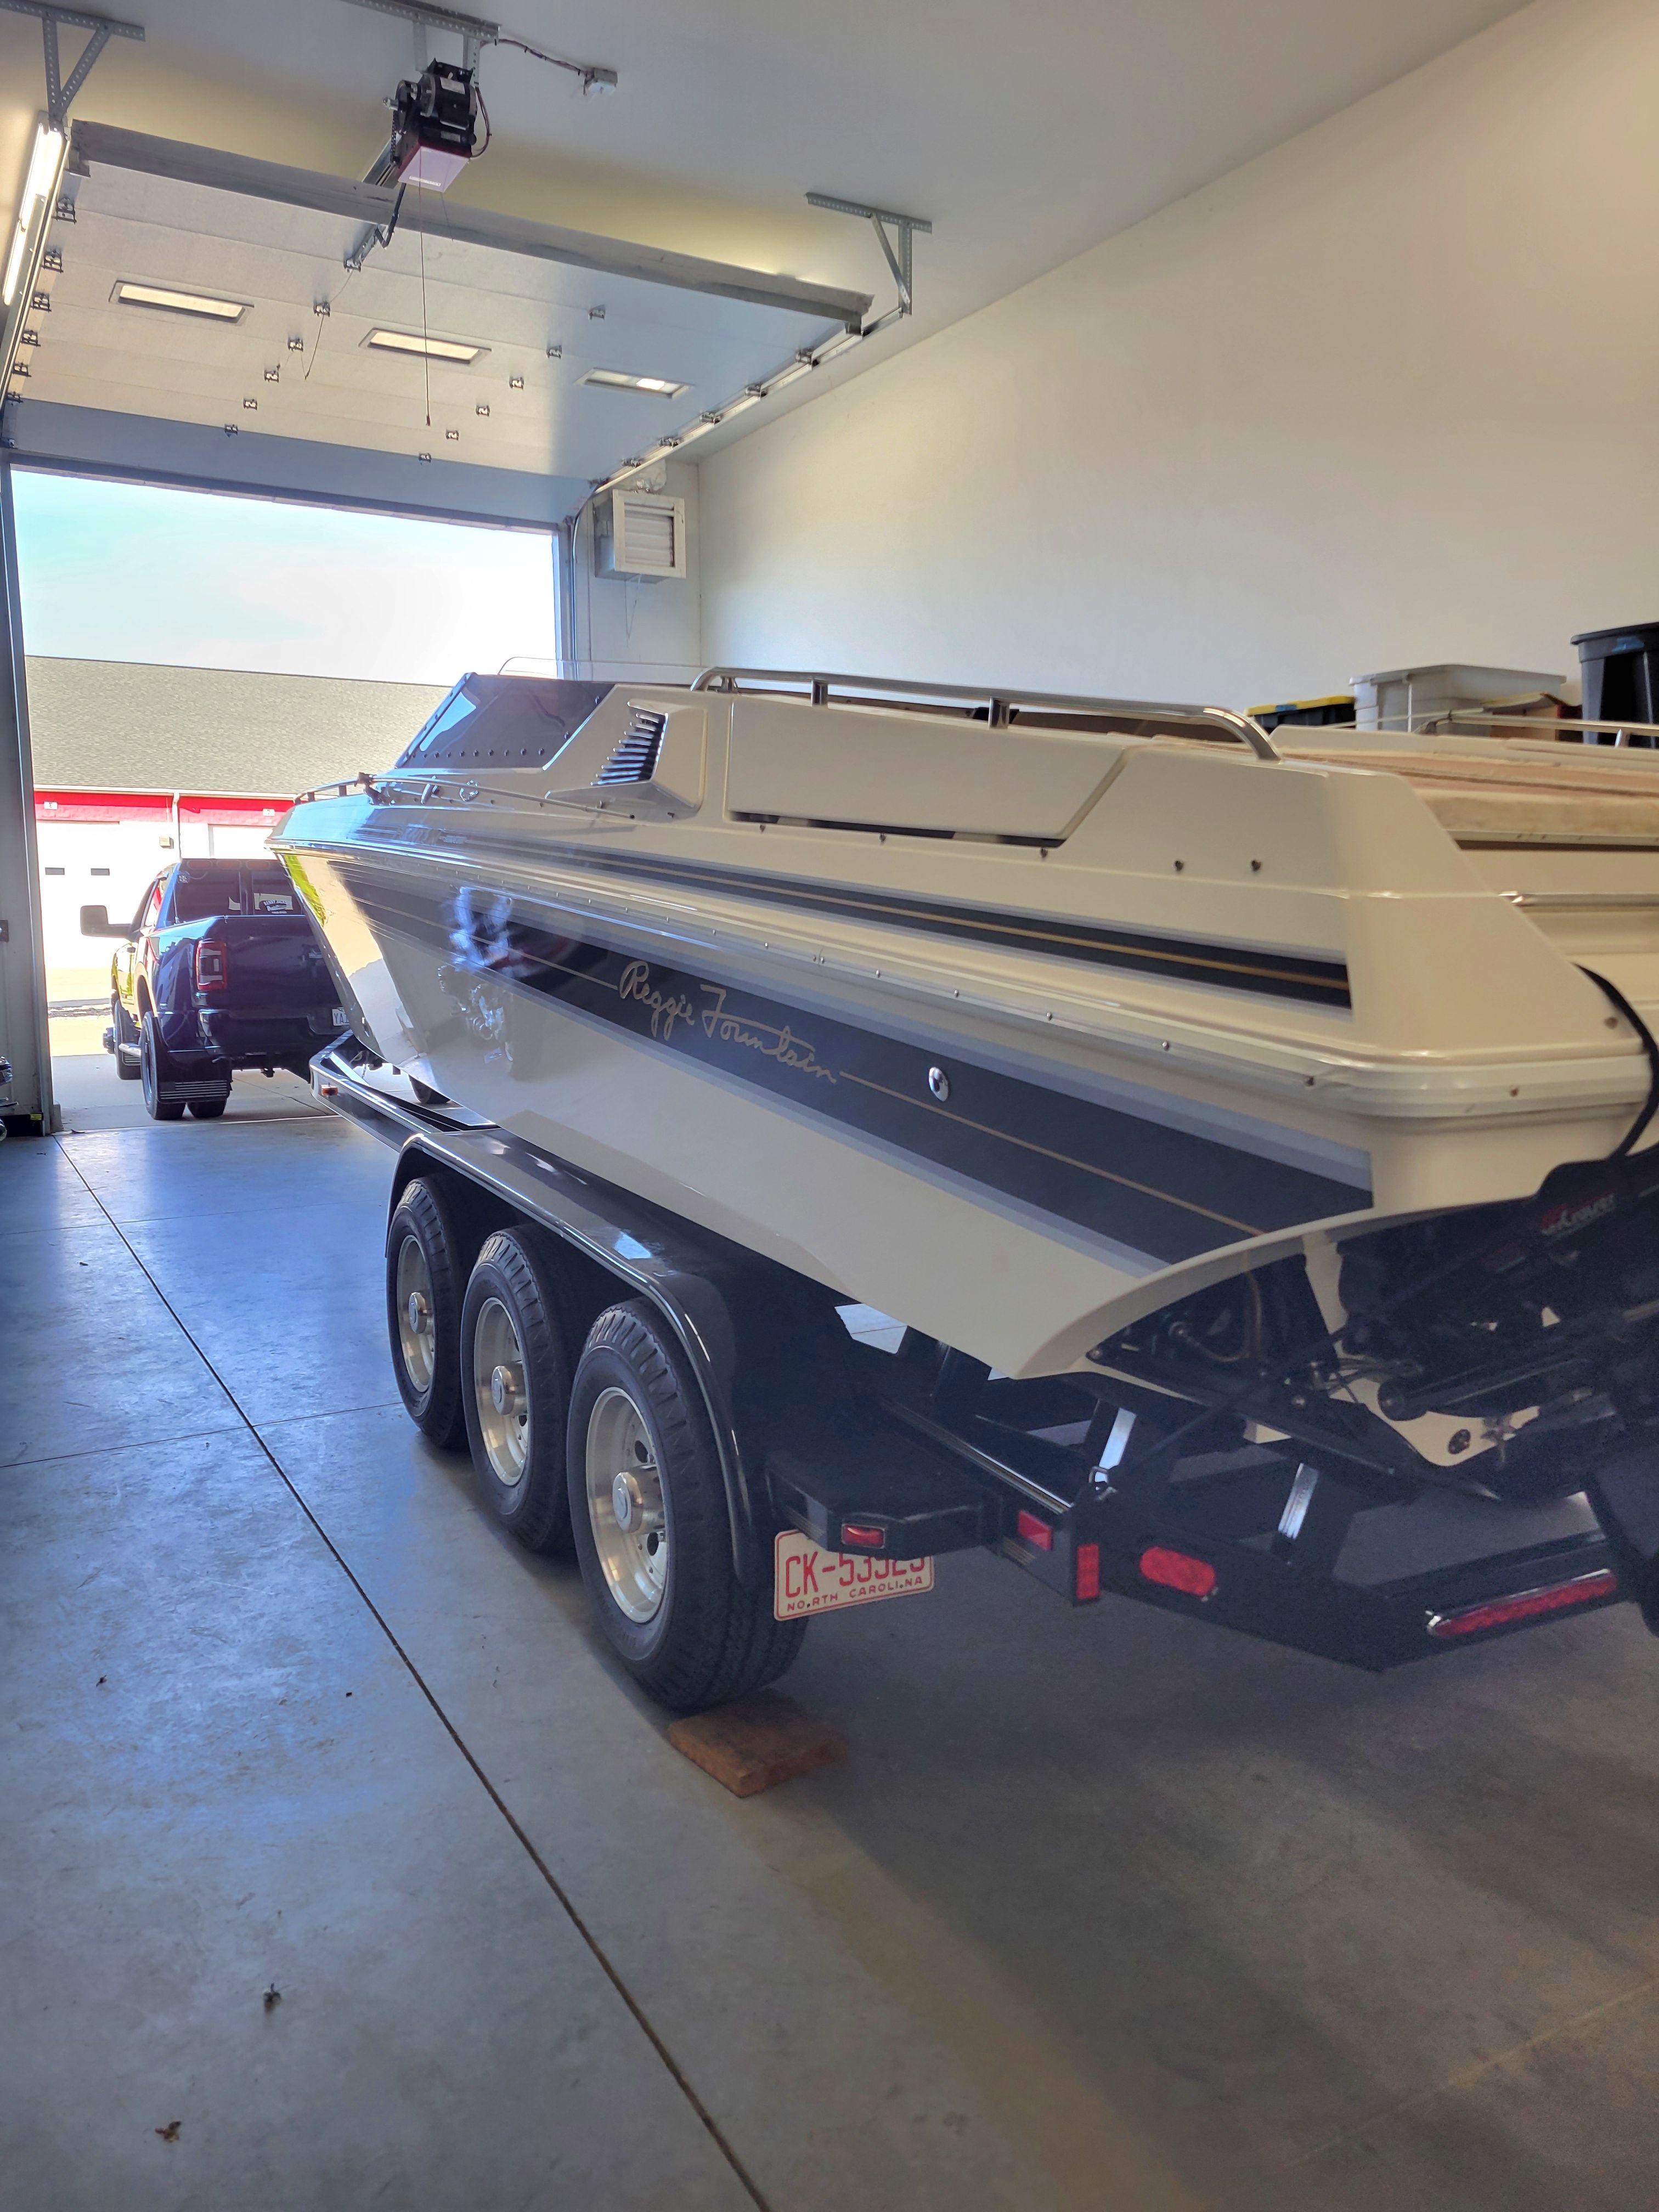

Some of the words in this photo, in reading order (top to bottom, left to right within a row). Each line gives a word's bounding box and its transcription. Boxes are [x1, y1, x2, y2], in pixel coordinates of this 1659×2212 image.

[619, 960, 695, 1041] Reggie
[700, 984, 838, 1084] Fountain
[787, 1593, 838, 1612] NORTH
[849, 1576, 923, 1598] CAROLINA
